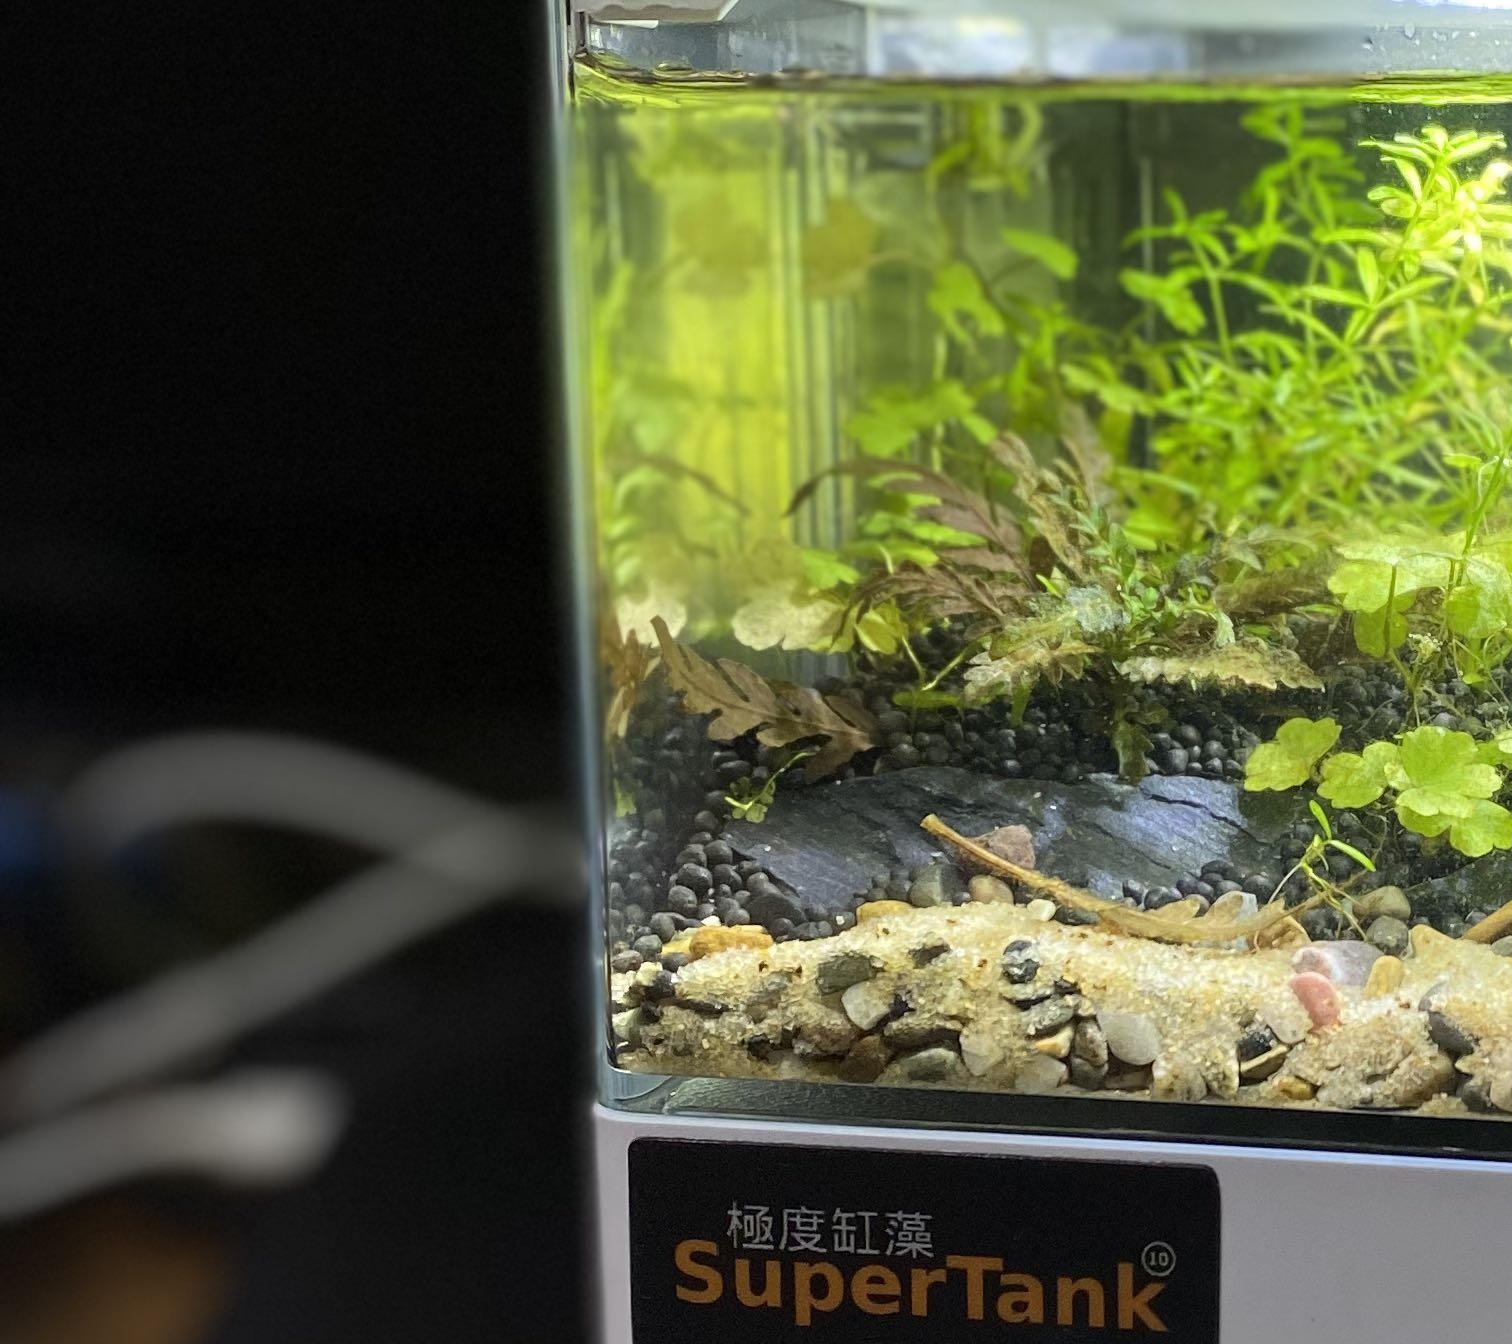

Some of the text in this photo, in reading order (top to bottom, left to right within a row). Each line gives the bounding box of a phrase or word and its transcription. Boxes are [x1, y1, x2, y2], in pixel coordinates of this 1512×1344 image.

[727, 1200, 934, 1258] 極度缸藻
[674, 1239, 1168, 1332] SuperTank
